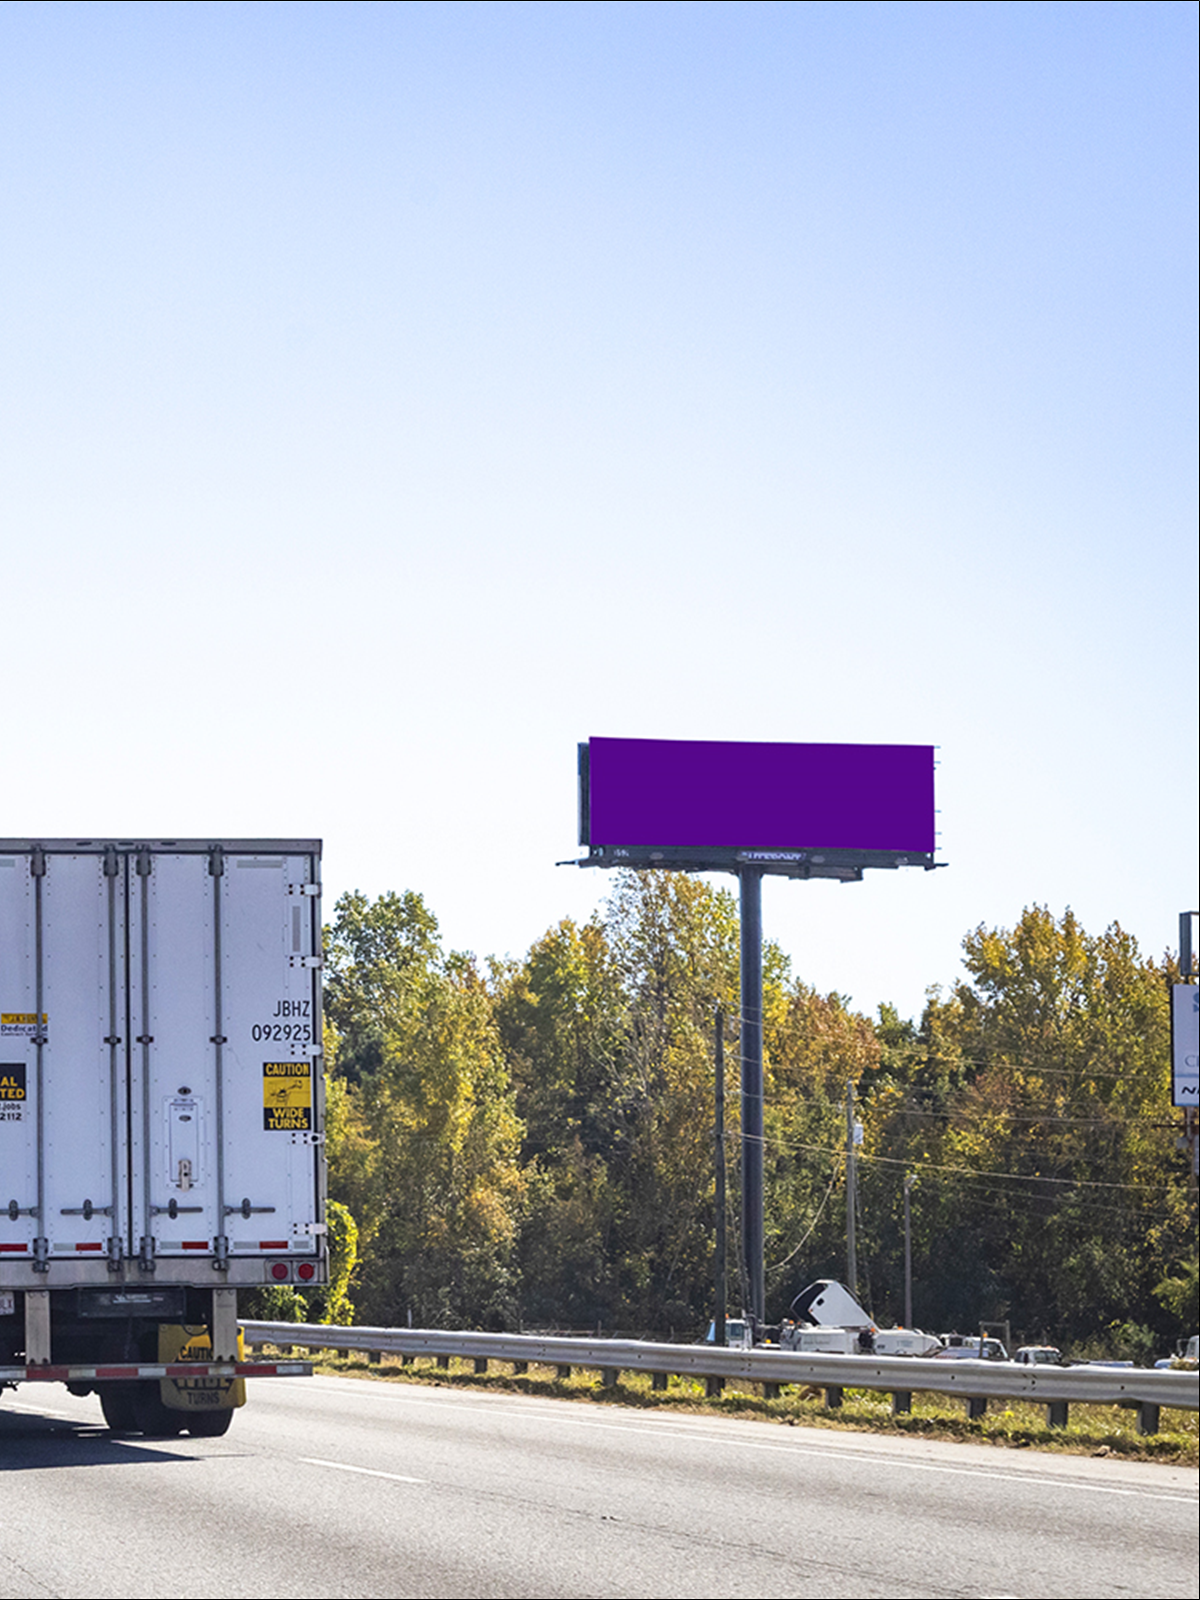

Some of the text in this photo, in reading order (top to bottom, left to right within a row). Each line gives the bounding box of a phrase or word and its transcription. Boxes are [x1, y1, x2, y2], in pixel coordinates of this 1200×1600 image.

[273, 1000, 310, 1017] JBHZ
[0, 1024, 48, 1032] Dedicatd
[252, 1024, 311, 1041] 092925
[265, 1063, 309, 1075] CAUTION
[273, 1108, 304, 1118] WIDE
[268, 1118, 308, 1129] TURNS
[181, 1347, 214, 1360] CAUTI
[186, 1393, 220, 1405] TURNS
